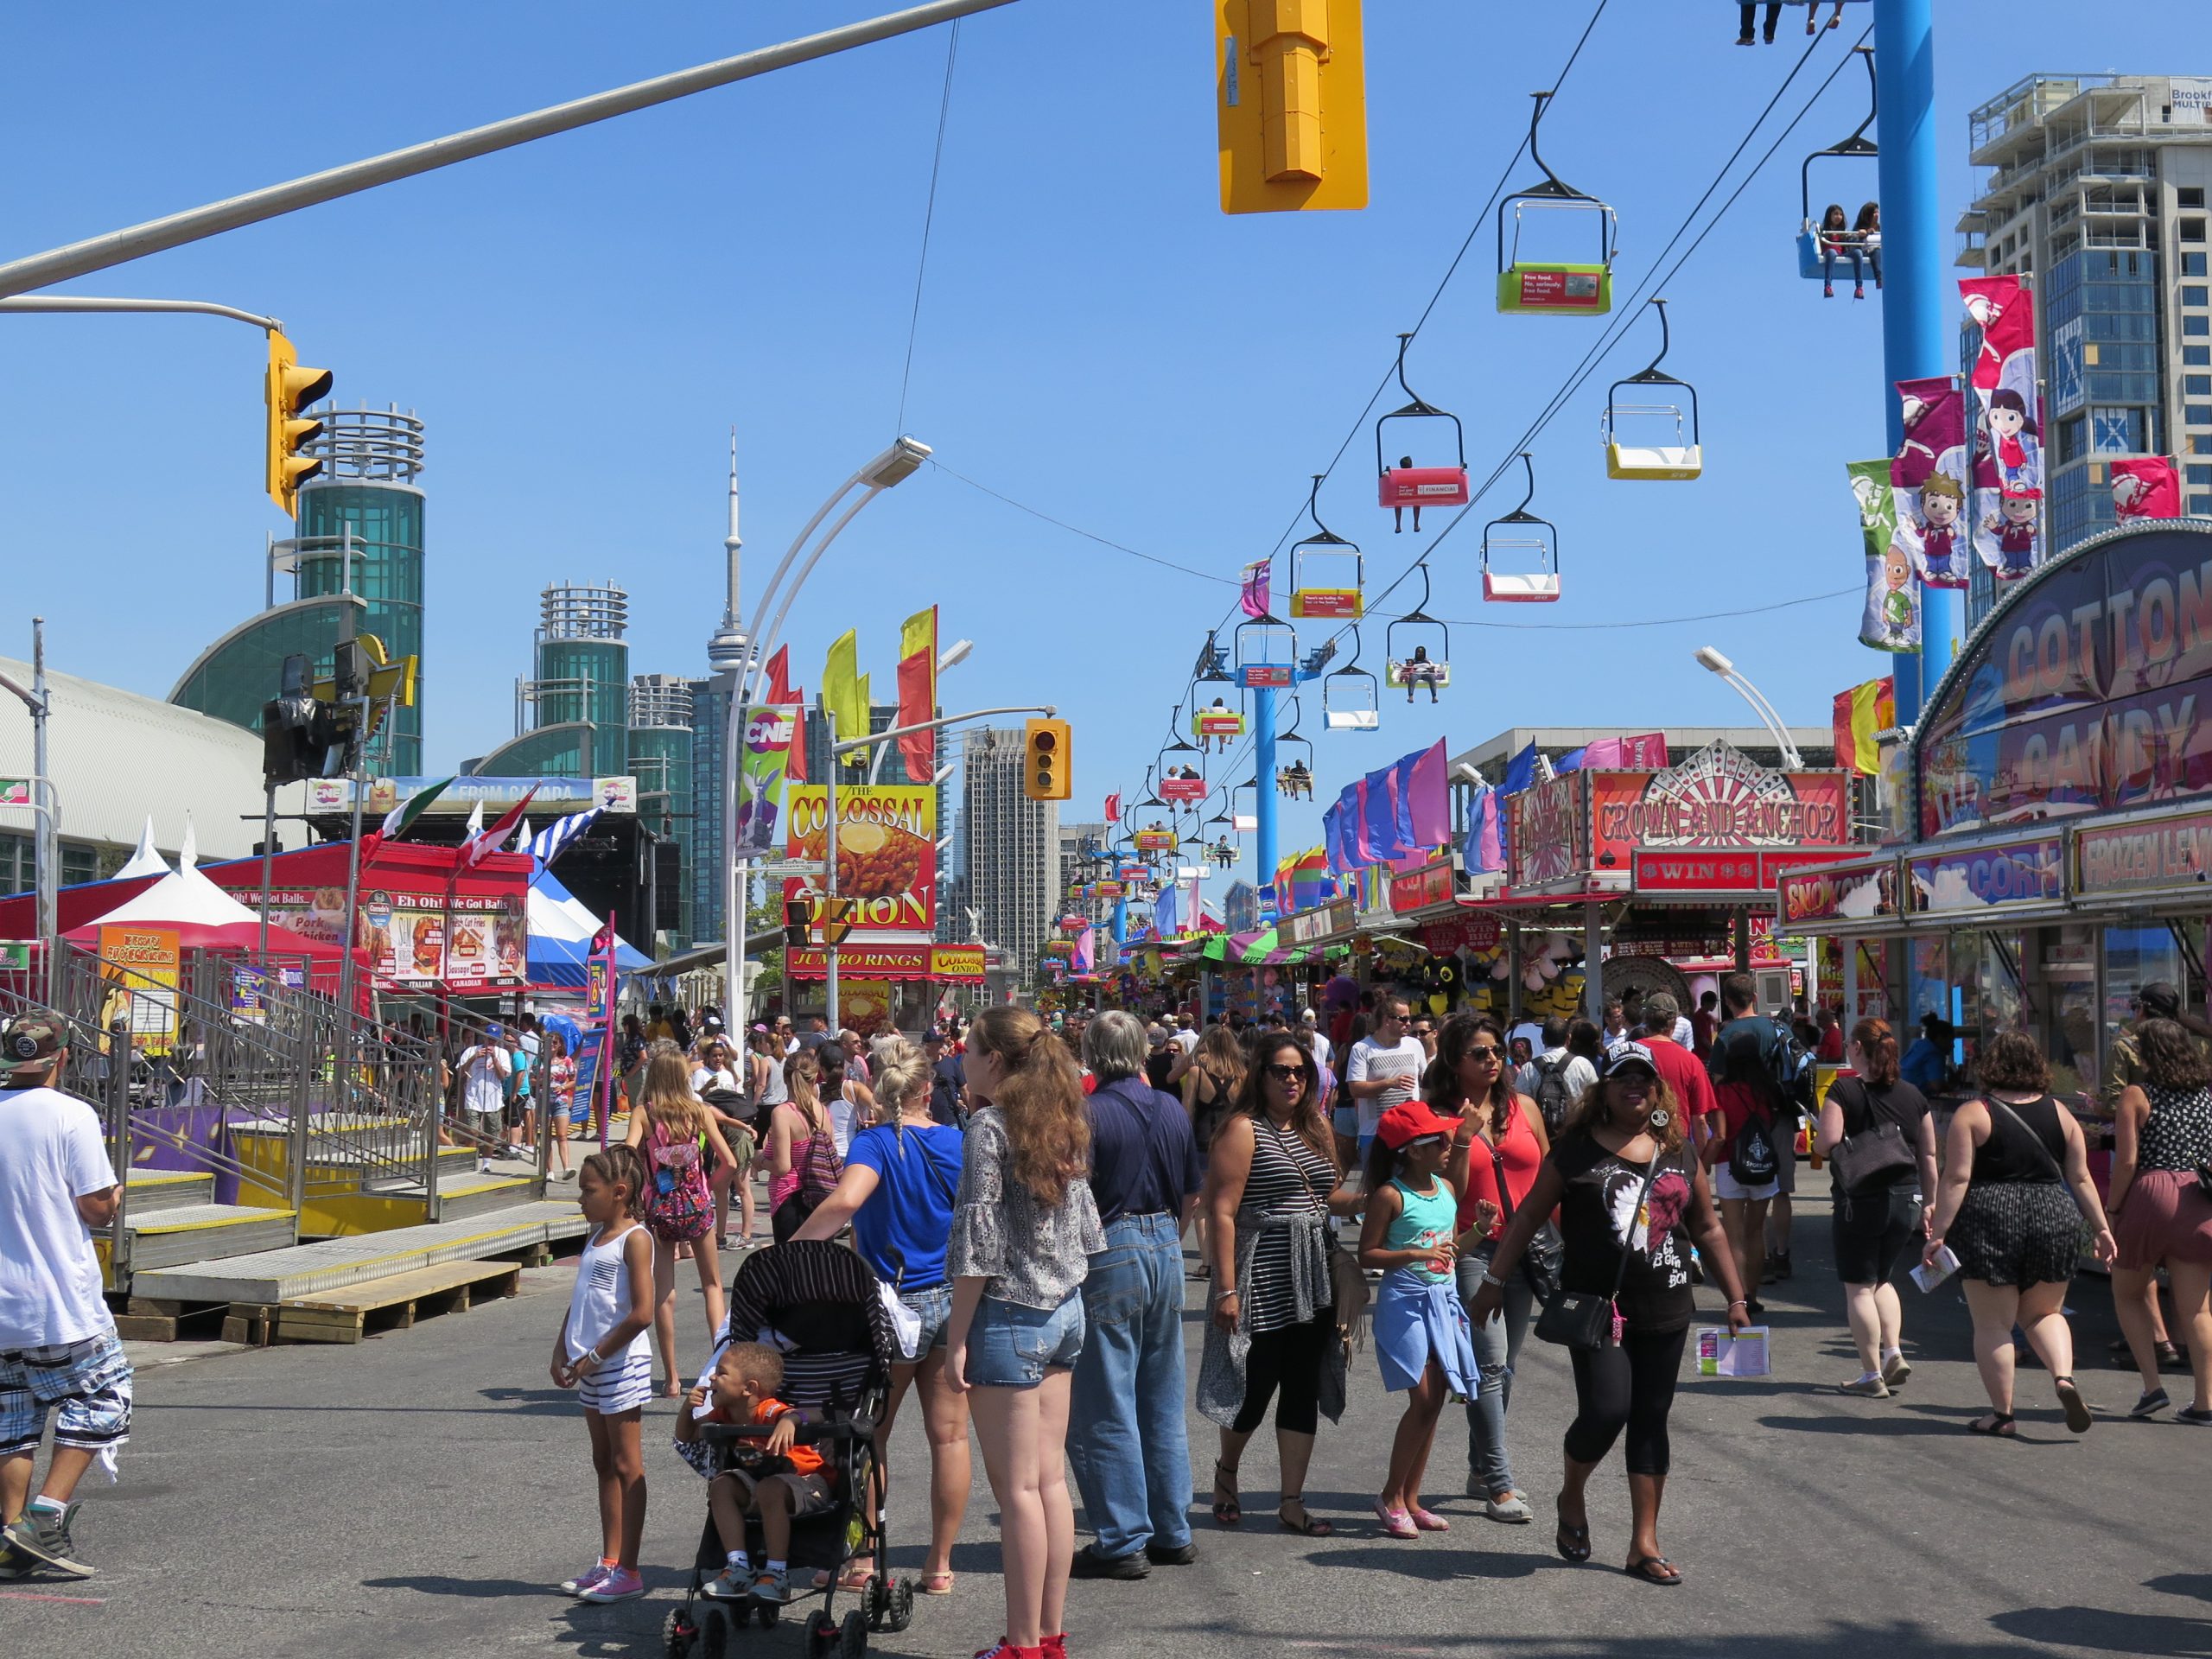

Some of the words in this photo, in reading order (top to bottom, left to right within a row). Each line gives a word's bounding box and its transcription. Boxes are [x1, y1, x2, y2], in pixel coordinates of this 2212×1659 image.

[2009, 560, 2212, 699] COTTON
[745, 721, 794, 744] CNE
[2022, 694, 2197, 799] CANDY
[315, 787, 342, 800] CNE
[408, 785, 453, 802] ME
[459, 785, 504, 802] FROM
[850, 787, 874, 796] THE
[792, 796, 931, 842] COLOSSAL
[1599, 798, 1681, 842] CROWN
[1687, 798, 1737, 838] AND
[1741, 798, 1838, 843] ANCHOR
[2087, 832, 2159, 887] FROZEN
[1661, 863, 1716, 880] WIN
[250, 893, 263, 904] We
[269, 893, 281, 904] ot
[397, 895, 416, 907] Eh
[419, 897, 443, 908] Oh!
[449, 898, 464, 909] We
[466, 898, 483, 909] Got
[485, 899, 509, 909] Balls
[296, 917, 325, 927] Pork
[474, 918, 486, 928] Fries
[864, 953, 924, 967] RINGS
[448, 964, 470, 976] Sausage
[452, 979, 482, 988] CANADIAN
[591, 982, 598, 1002] 6
[839, 985, 888, 999] OLOSSAL
[1608, 1042, 1630, 1062] NEW
[1629, 1040, 1653, 1061] YORK
[1652, 1252, 1681, 1269] Born
[1669, 1270, 1688, 1288] BCN
